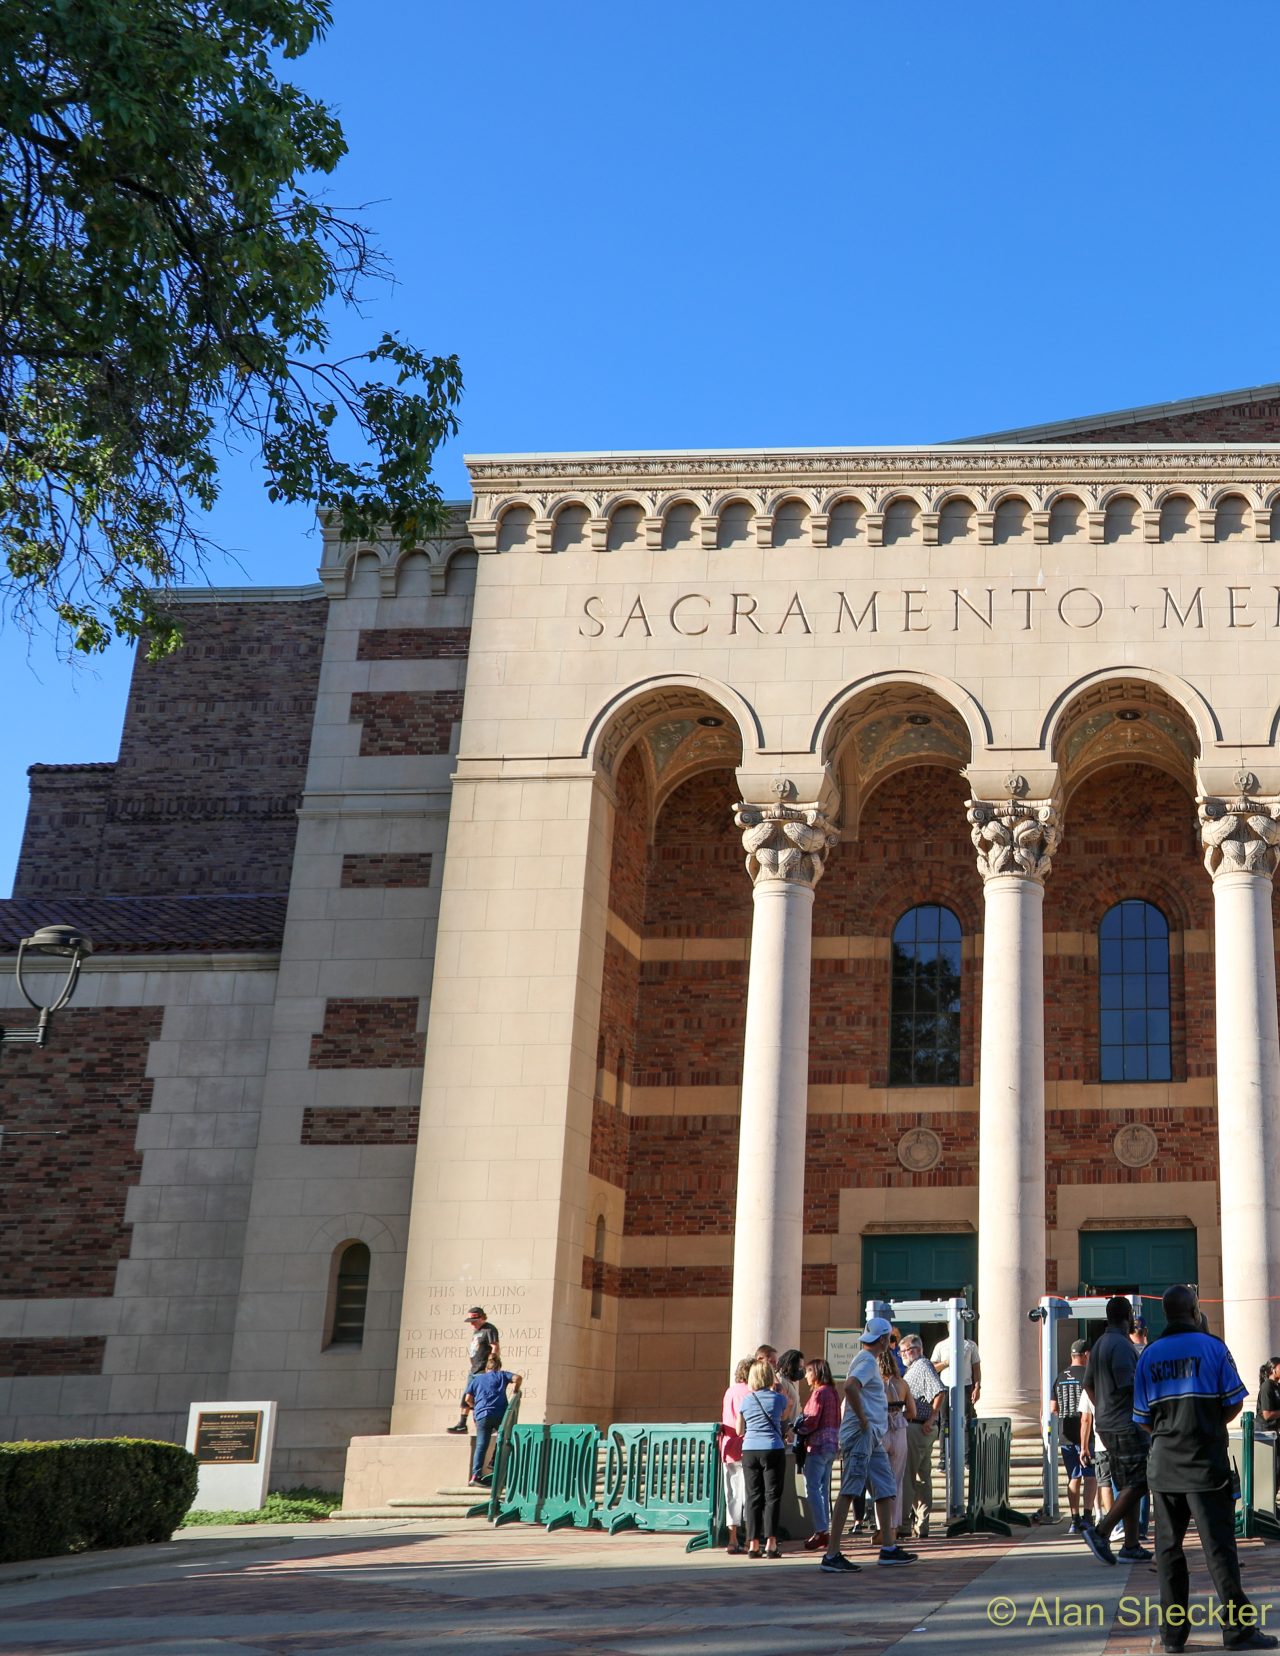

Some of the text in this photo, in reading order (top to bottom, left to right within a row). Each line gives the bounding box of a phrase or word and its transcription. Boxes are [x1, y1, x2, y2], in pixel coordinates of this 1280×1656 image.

[578, 587, 1104, 638] SACRAMENTO
[427, 1286, 455, 1298] THIS
[429, 1303, 522, 1316] IS DECATED
[405, 1329, 422, 1341] TO
[427, 1328, 467, 1341] THOSE
[509, 1327, 545, 1340] MADE
[403, 1347, 427, 1359] THE
[500, 1345, 544, 1359] CRIFICE
[412, 1370, 428, 1382] IN
[431, 1369, 456, 1382] THE
[1150, 1356, 1202, 1384] SECURITY
[402, 1388, 428, 1401] THE
